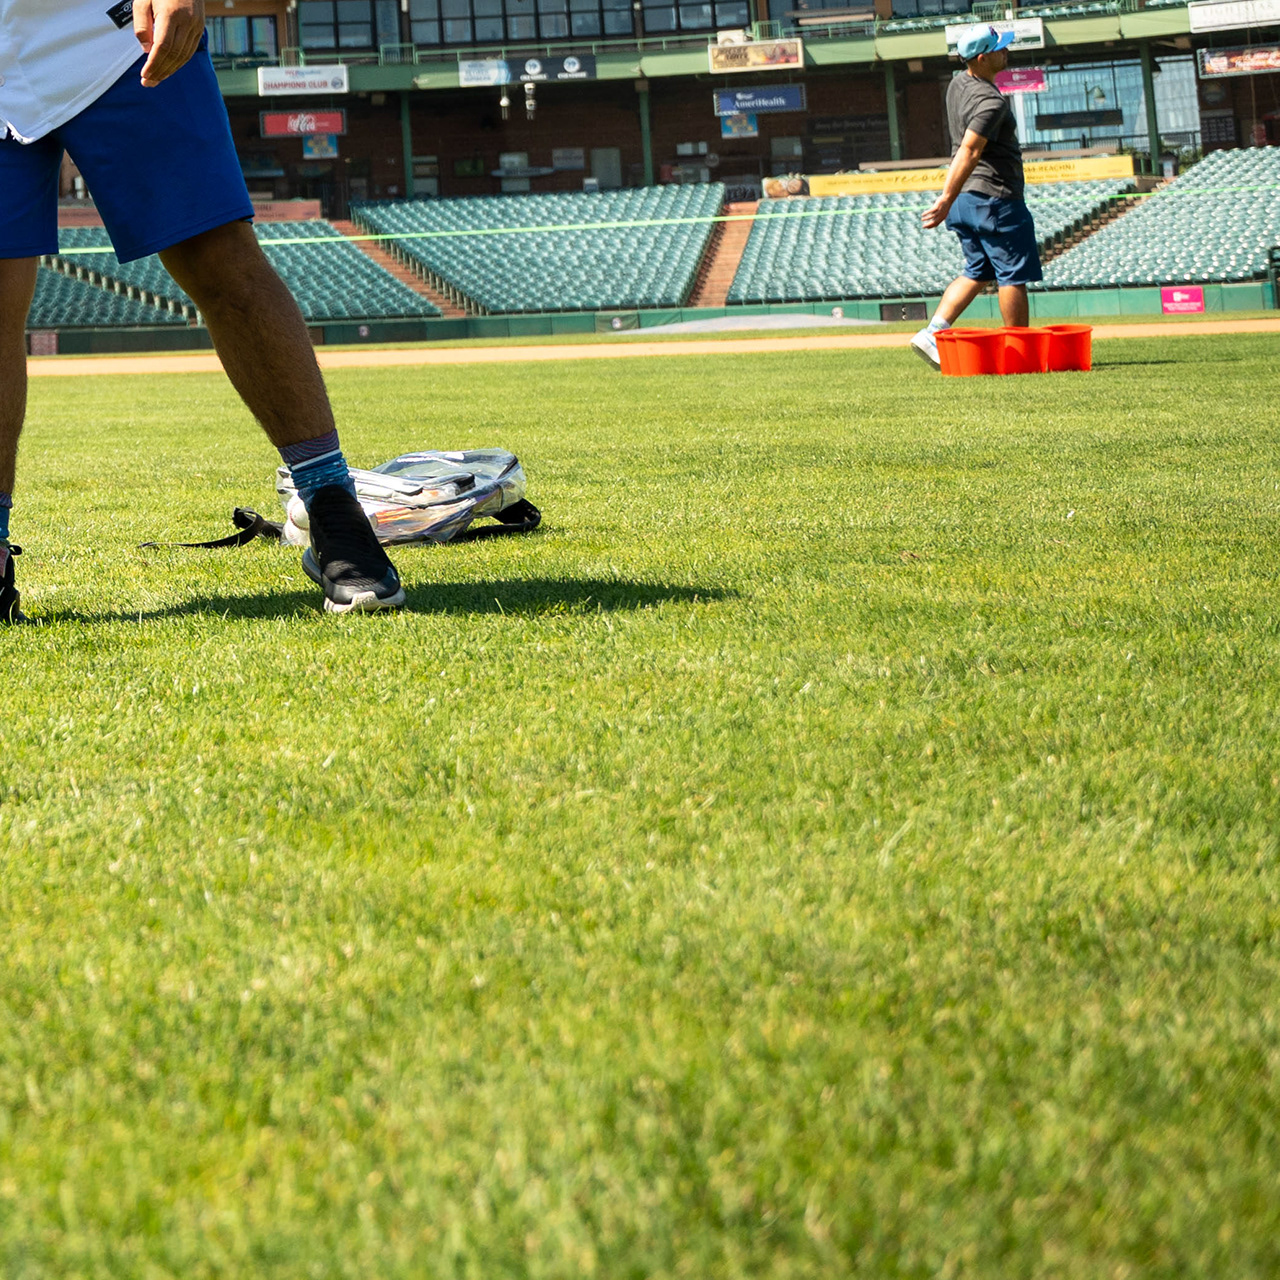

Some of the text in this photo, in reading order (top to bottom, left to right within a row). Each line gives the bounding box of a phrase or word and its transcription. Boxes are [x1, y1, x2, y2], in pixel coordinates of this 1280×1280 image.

[309, 80, 328, 89] CLUB
[734, 97, 786, 109] AmeriHealth
[894, 171, 946, 184] recove
